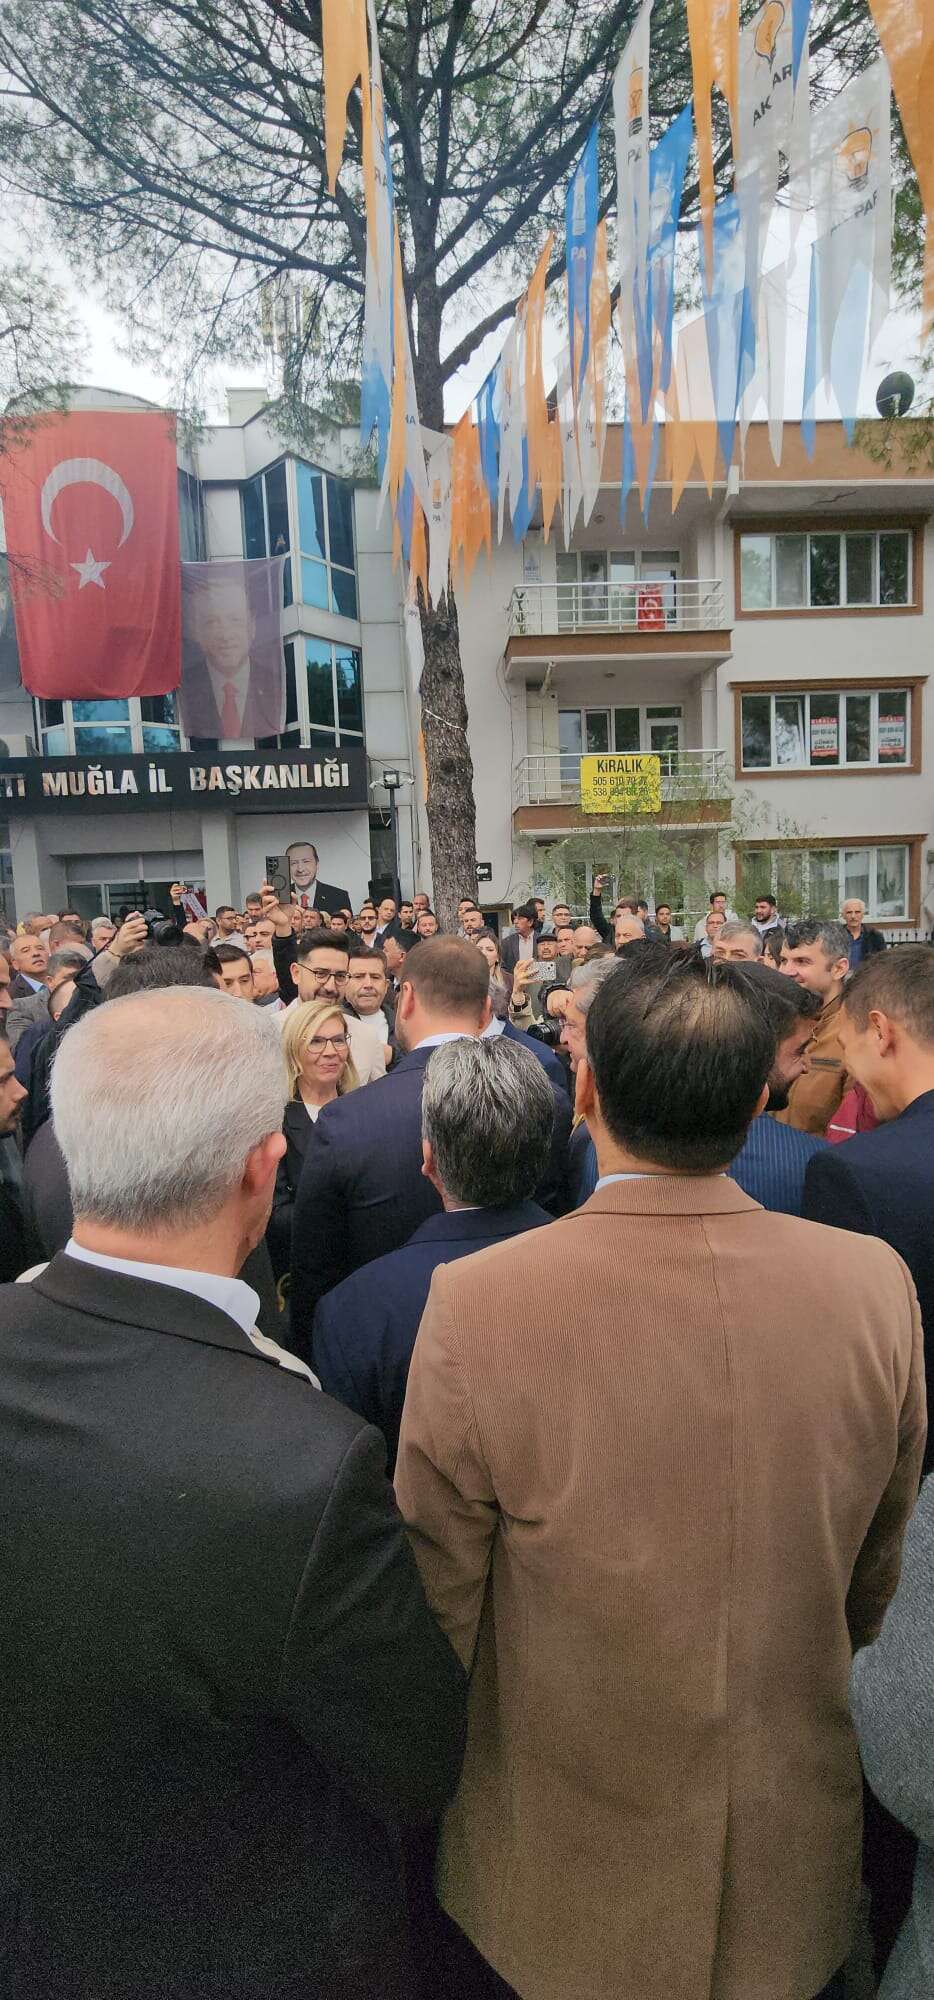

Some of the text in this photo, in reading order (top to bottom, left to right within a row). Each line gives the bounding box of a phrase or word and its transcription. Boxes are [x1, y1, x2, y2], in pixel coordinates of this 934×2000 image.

[772, 63, 792, 89] AR
[41, 763, 140, 797] MUĞLA
[148, 762, 173, 794] İL
[189, 757, 350, 796] BAŞKANLIĞI
[592, 776, 607, 786] 505
[609, 776, 624, 786] 610
[592, 787, 607, 796] 538
